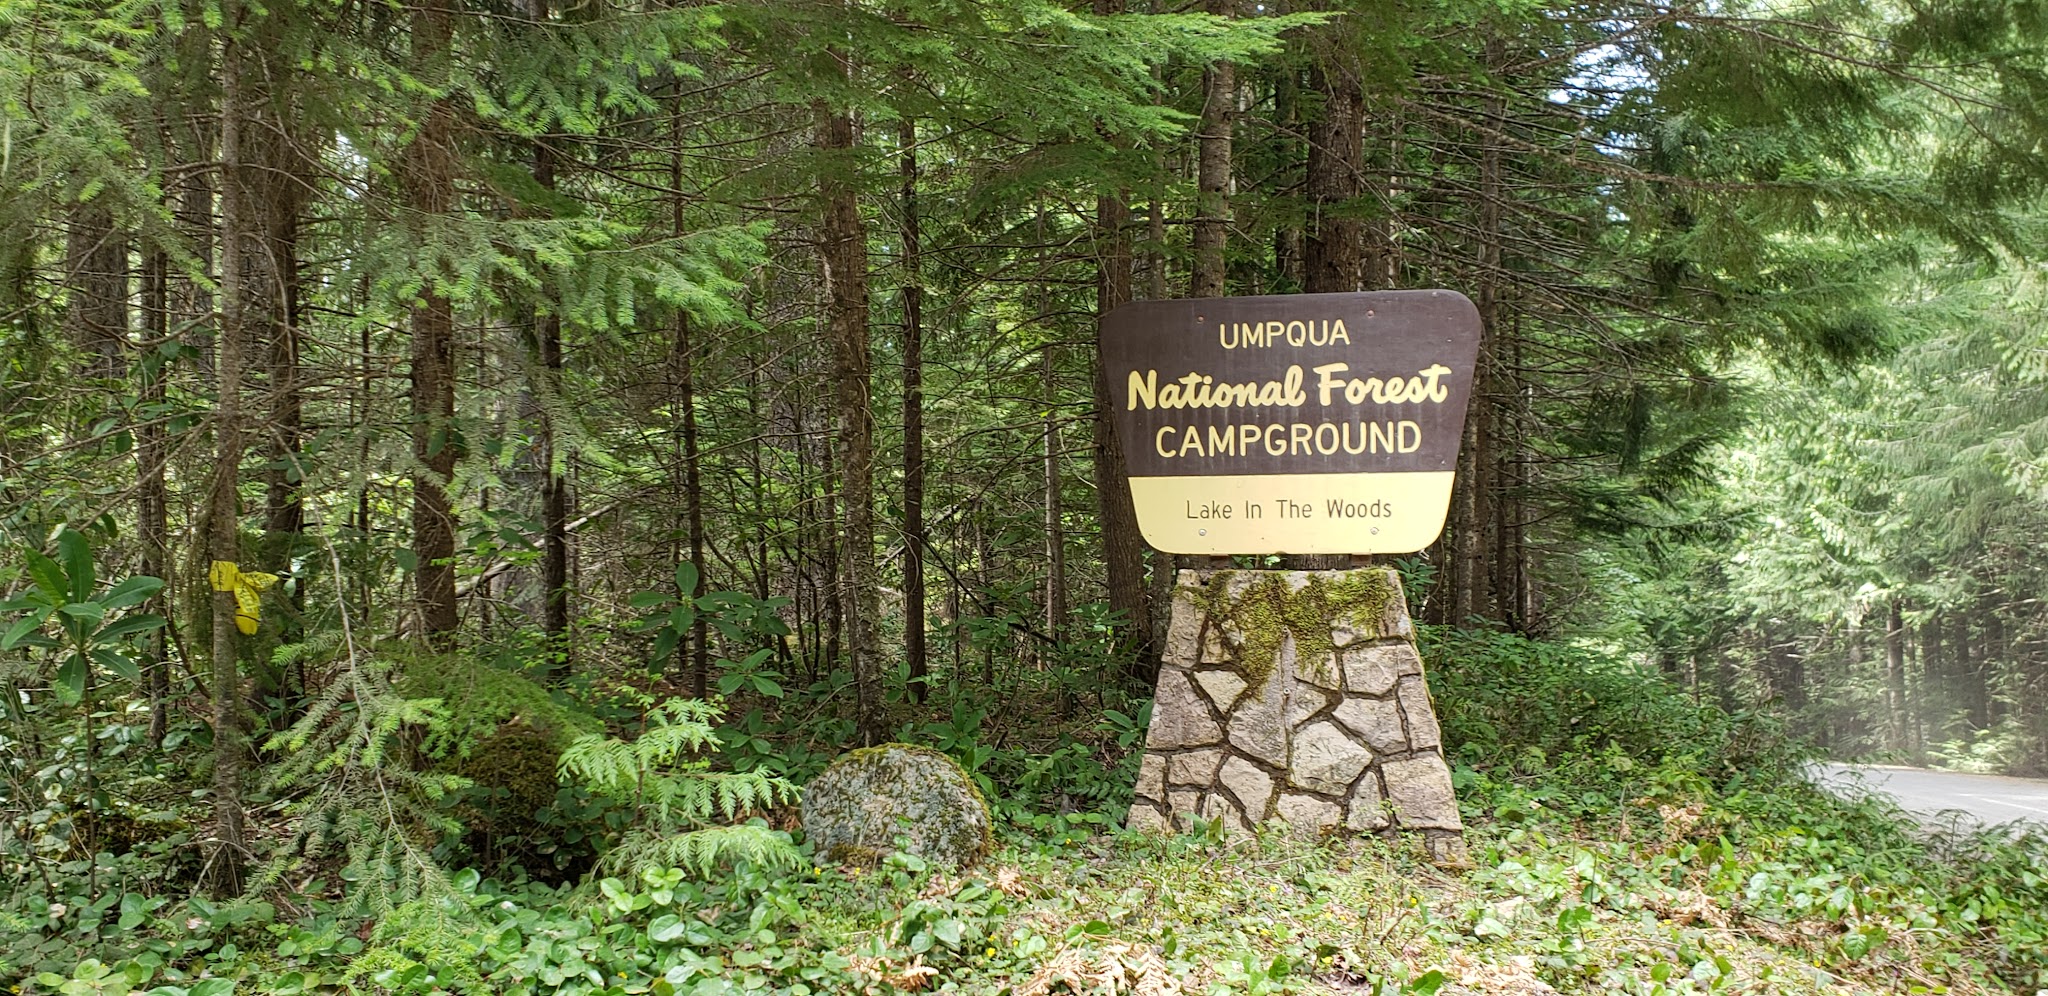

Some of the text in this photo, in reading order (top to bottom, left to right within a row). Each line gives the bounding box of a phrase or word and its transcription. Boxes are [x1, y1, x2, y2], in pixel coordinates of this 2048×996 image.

[1219, 319, 1351, 349] UMPQUA
[1127, 362, 1453, 411] National Forest
[1155, 420, 1422, 458] CAMPGROUND
[1186, 498, 1392, 520] Lake In The Woods
